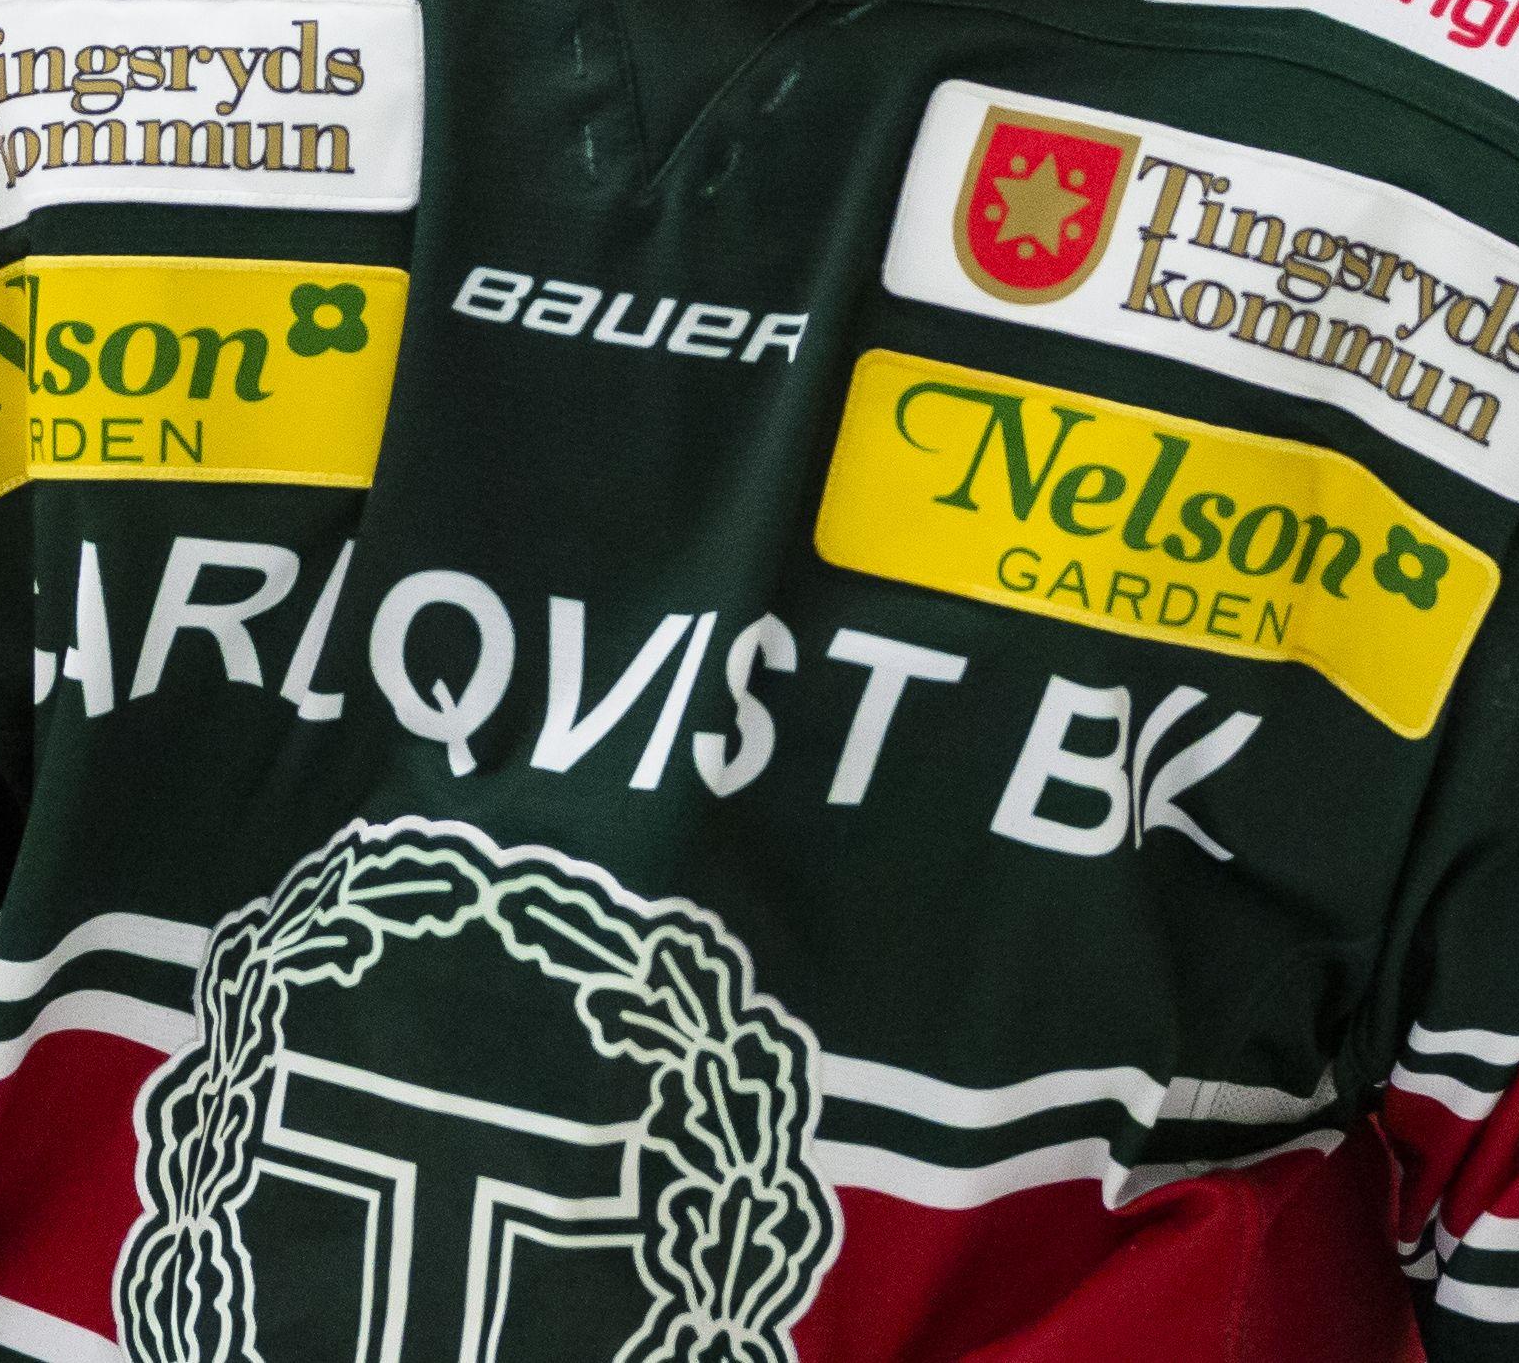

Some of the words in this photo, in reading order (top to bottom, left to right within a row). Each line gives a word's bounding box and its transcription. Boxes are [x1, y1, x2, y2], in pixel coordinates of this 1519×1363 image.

[1120, 227, 1503, 447] kommun
[893, 380, 1362, 601] Nelson
[997, 547, 1294, 646] GARDEN
[34, 536, 969, 807] ARLQVIST
[990, 674, 1263, 863] BK
